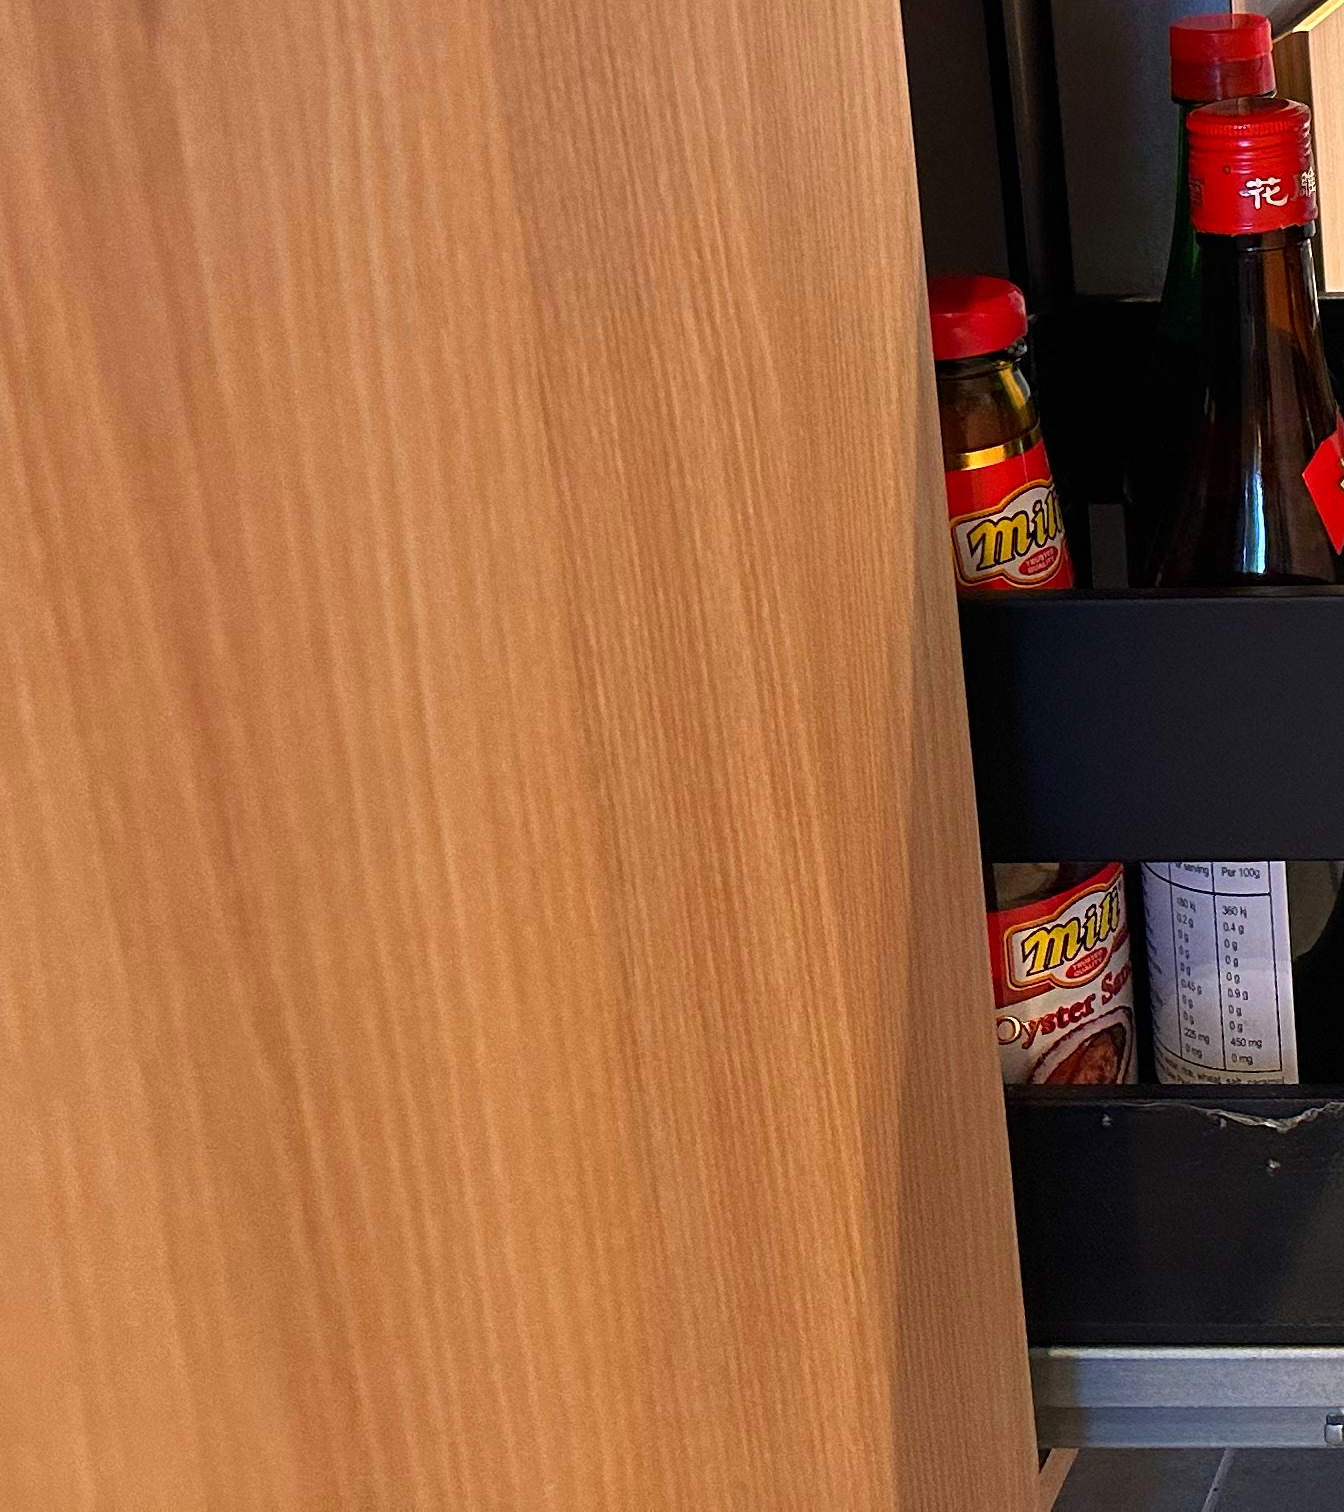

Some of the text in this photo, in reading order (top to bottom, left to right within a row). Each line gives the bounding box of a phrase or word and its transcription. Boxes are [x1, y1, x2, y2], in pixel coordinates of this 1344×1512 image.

[1221, 866, 1261, 879] Per 100g
[1101, 962, 1131, 1005] Sau
[996, 993, 1096, 1050] Oyster
[1230, 1038, 1246, 1047] 450
